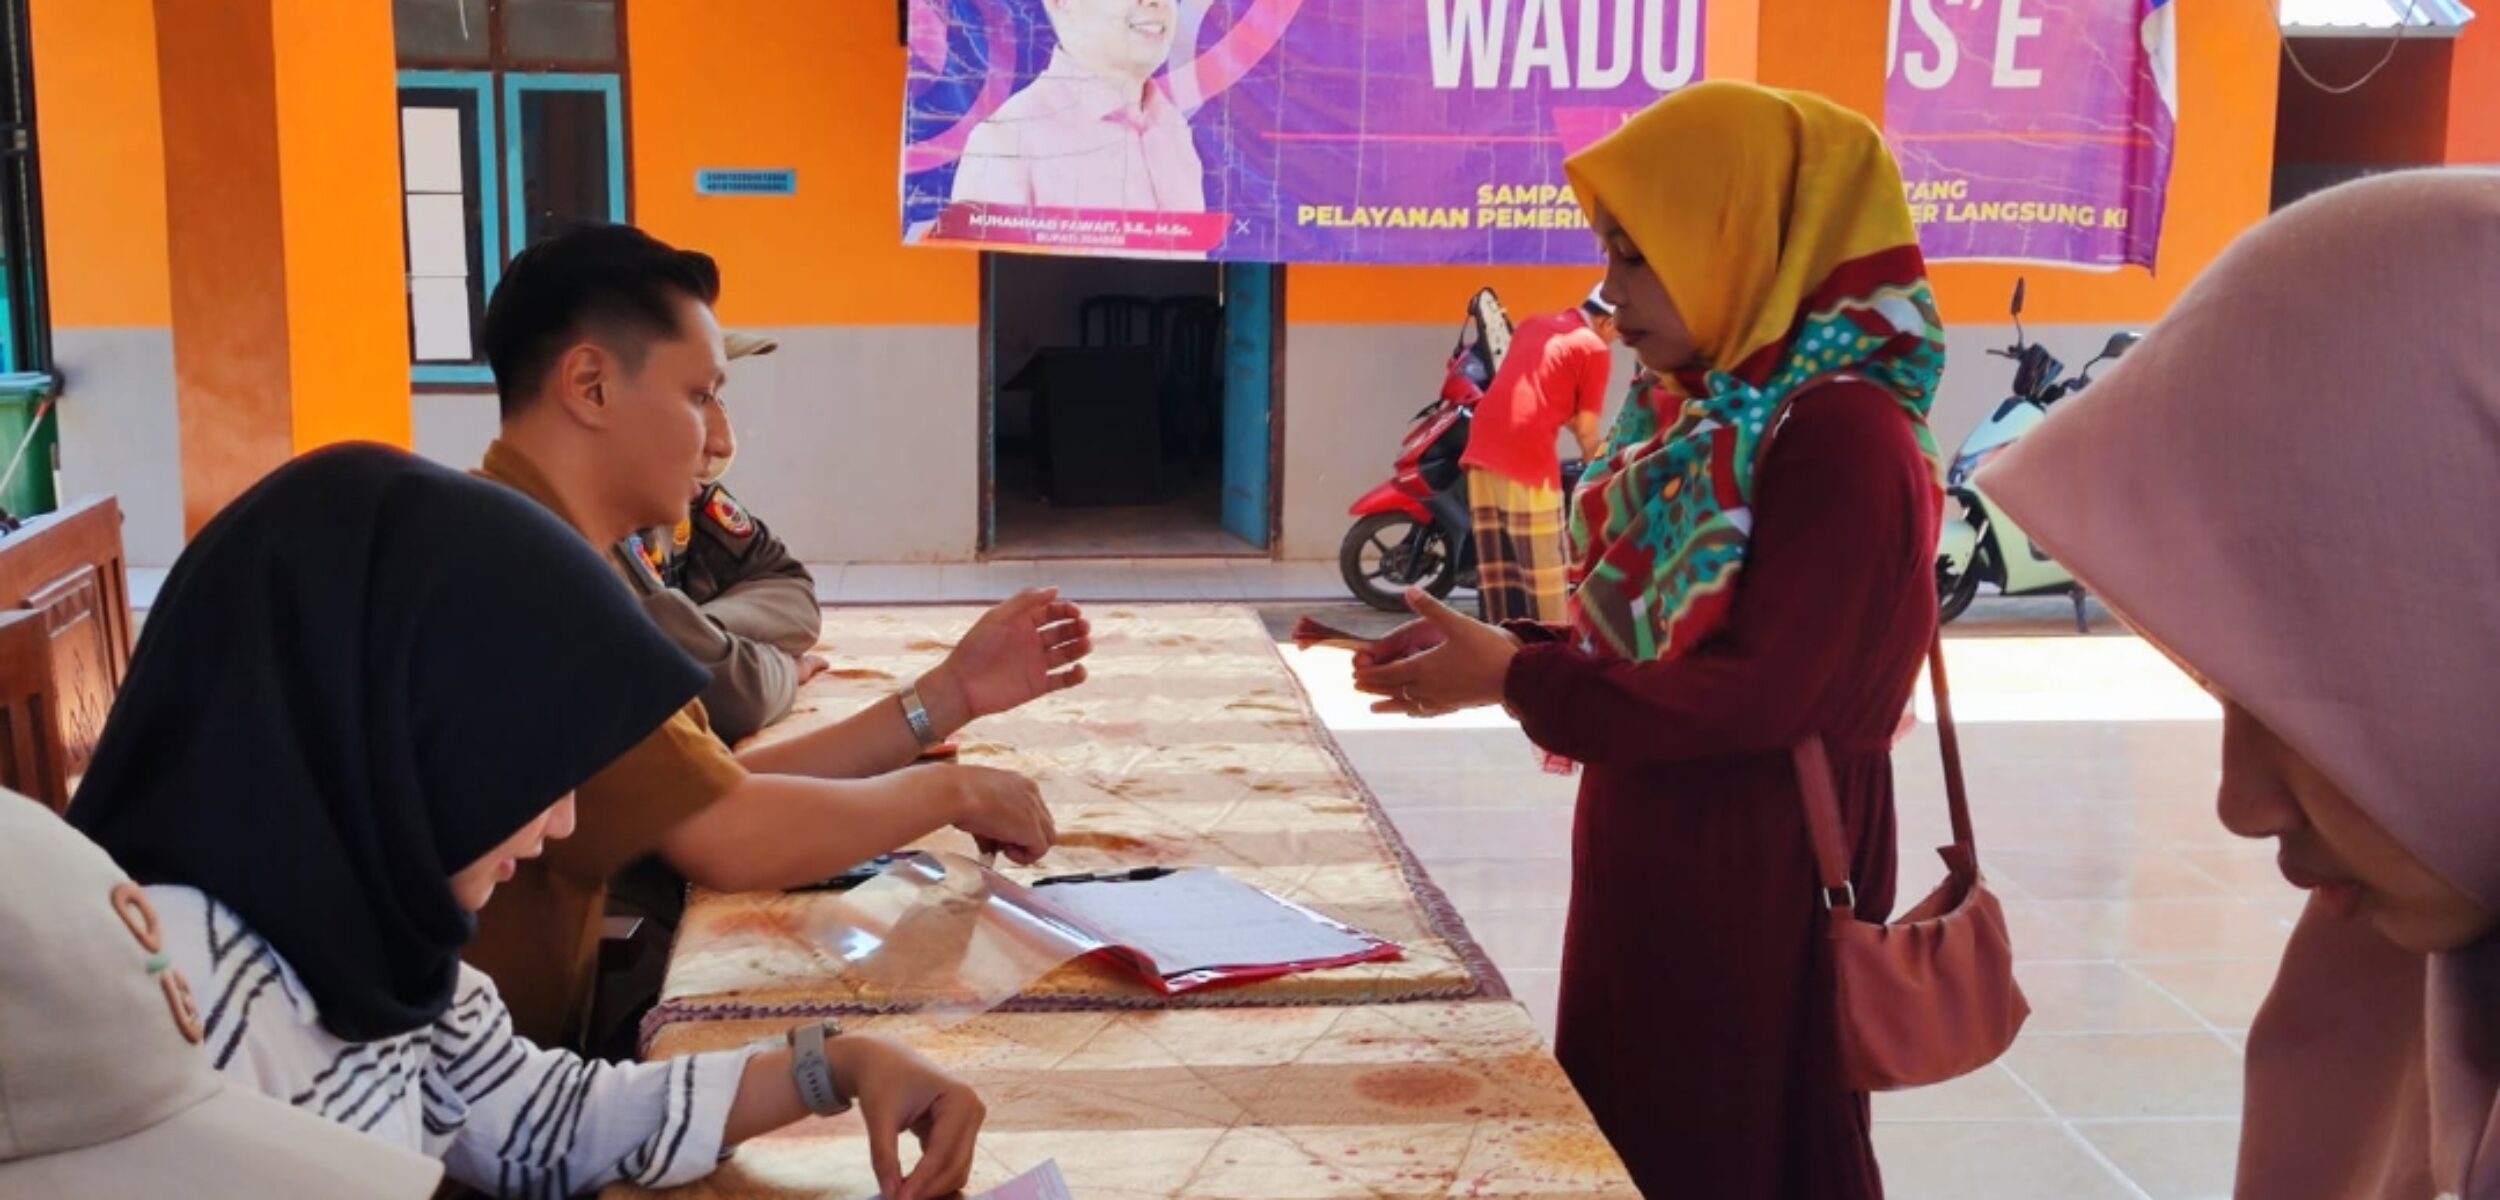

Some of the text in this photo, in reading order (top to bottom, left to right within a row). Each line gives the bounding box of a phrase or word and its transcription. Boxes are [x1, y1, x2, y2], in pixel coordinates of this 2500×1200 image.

[1477, 179, 1969, 206] SAMPA TANG
[969, 214, 1057, 230] MUHAMMAD
[1297, 205, 1470, 228] PELAYANAN
[1476, 206, 1591, 229] PEMERI
[1908, 203, 1939, 224] ER
[1945, 201, 2095, 227] LANGSUNG
